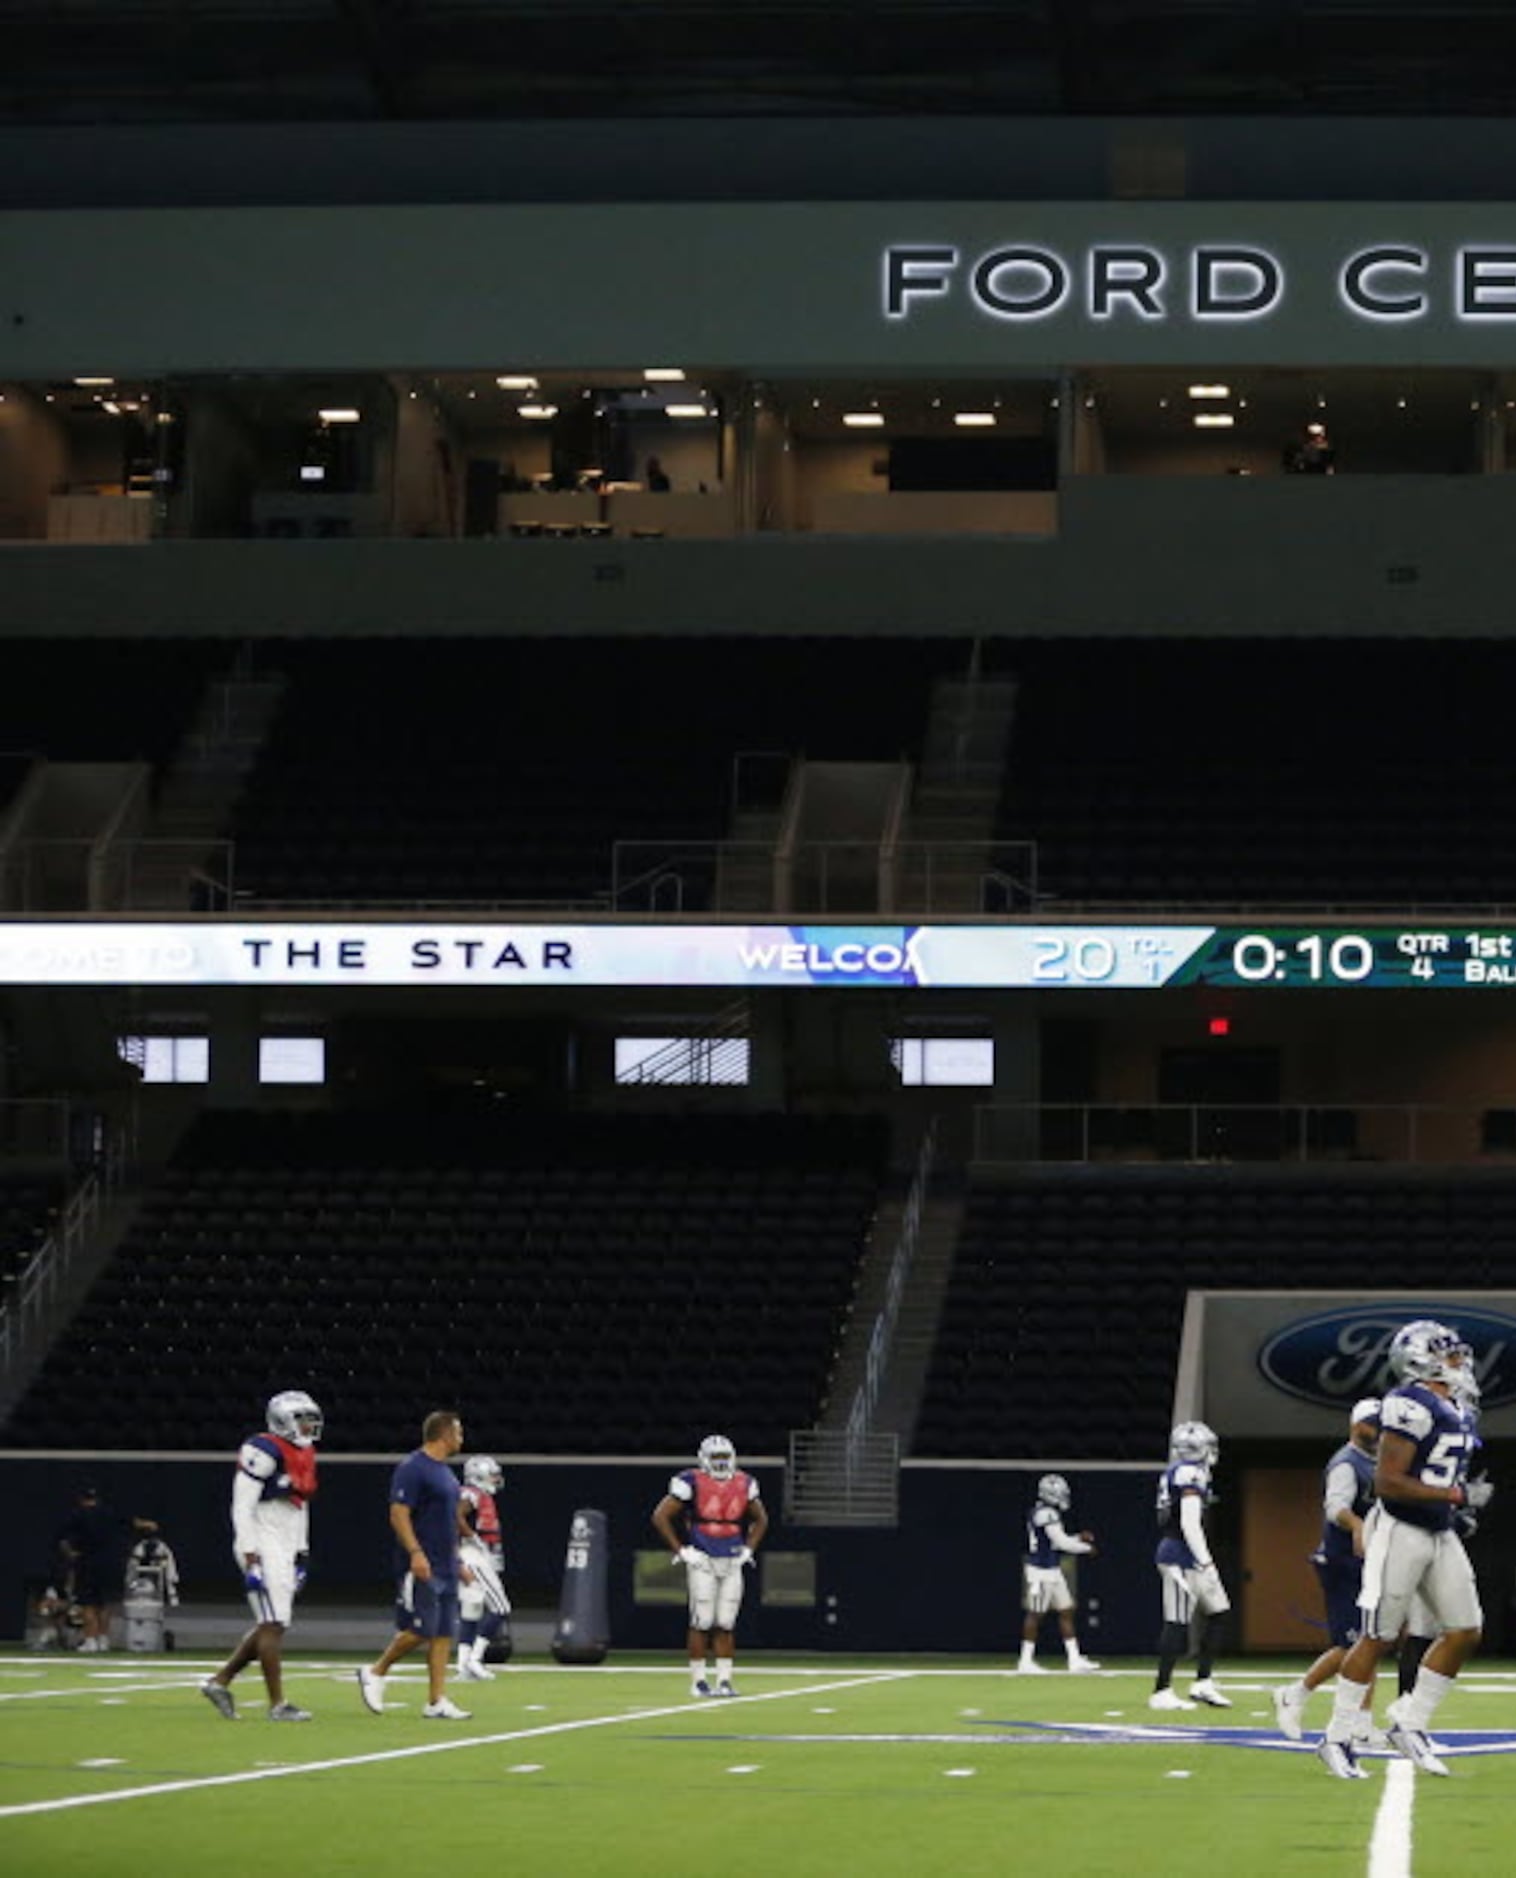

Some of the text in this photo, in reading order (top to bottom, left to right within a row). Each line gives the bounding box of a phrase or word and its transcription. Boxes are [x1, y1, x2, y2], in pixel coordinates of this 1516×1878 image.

[885, 247, 1282, 318] FORD
[243, 940, 366, 968] THE
[411, 940, 573, 969] STAR
[1031, 937, 1117, 981] 20
[1233, 935, 1373, 980] 0:10
[1397, 934, 1449, 955] QTR
[1465, 933, 1512, 957] 1st
[1411, 955, 1435, 980] 4
[1420, 1433, 1474, 1487] 5
